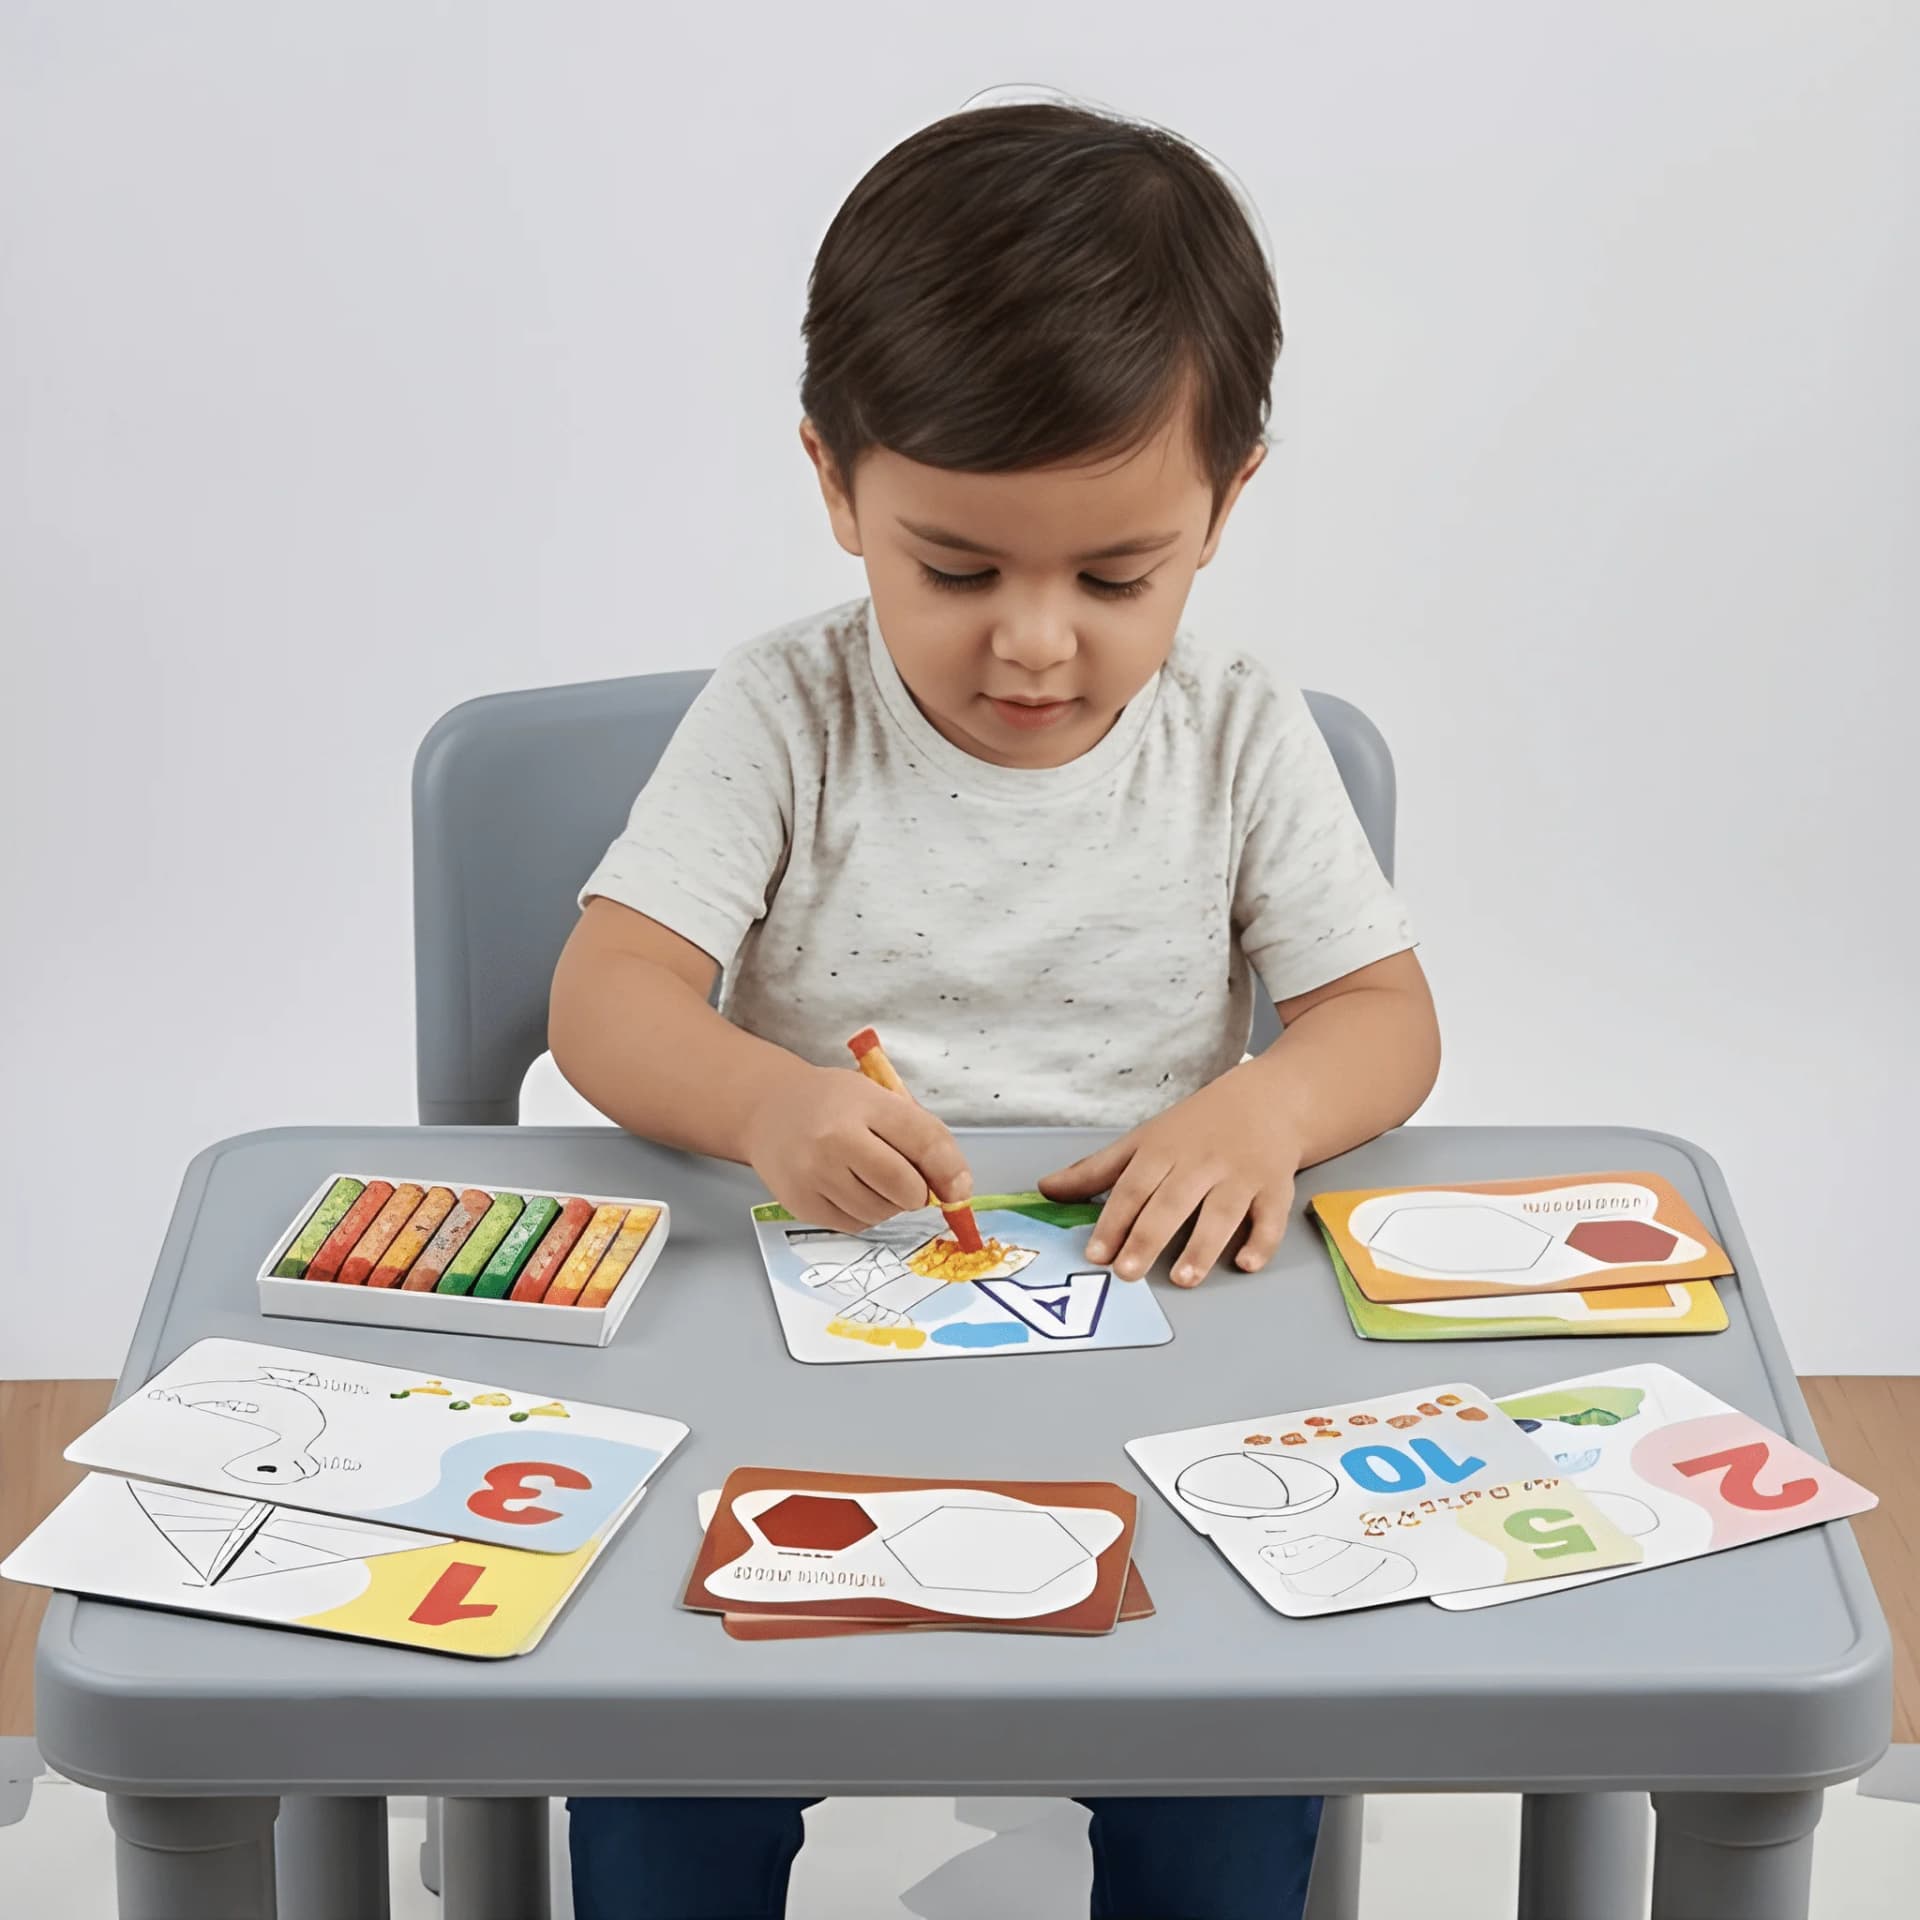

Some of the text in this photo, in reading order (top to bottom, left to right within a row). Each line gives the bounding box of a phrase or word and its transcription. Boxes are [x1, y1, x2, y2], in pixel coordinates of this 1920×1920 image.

[972, 1272, 1111, 1338] A
[467, 1461, 592, 1525] 3
[1340, 1438, 1487, 1493] 10
[1672, 1442, 1819, 1511] 2
[1505, 1508, 1597, 1559] 5
[408, 1562, 498, 1625] 1
